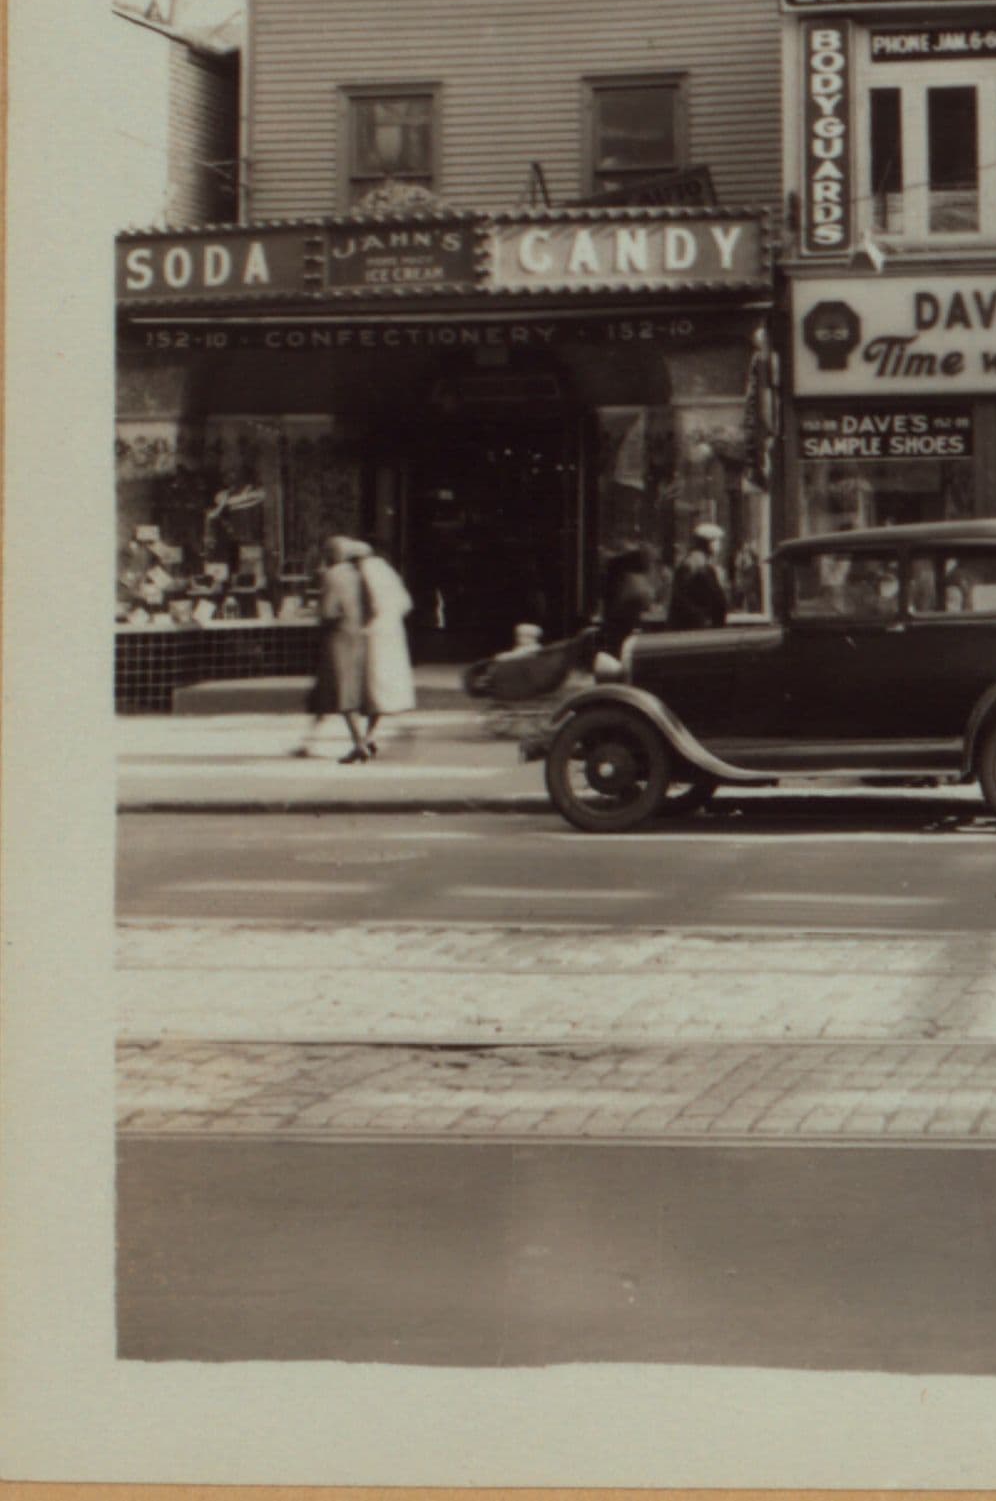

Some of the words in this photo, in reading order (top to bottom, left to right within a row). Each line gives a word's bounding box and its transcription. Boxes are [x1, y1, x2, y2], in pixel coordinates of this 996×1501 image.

[872, 34, 930, 54] PHONE
[810, 29, 846, 245] BODYGUARDS
[332, 230, 461, 259] JAHN'S
[519, 226, 742, 272] CANDY
[126, 242, 271, 290] SODA
[265, 323, 556, 349] CONFECTIONERY
[862, 334, 967, 377] Time
[803, 437, 881, 456] SAMPLE
[889, 435, 965, 453] SHOES
